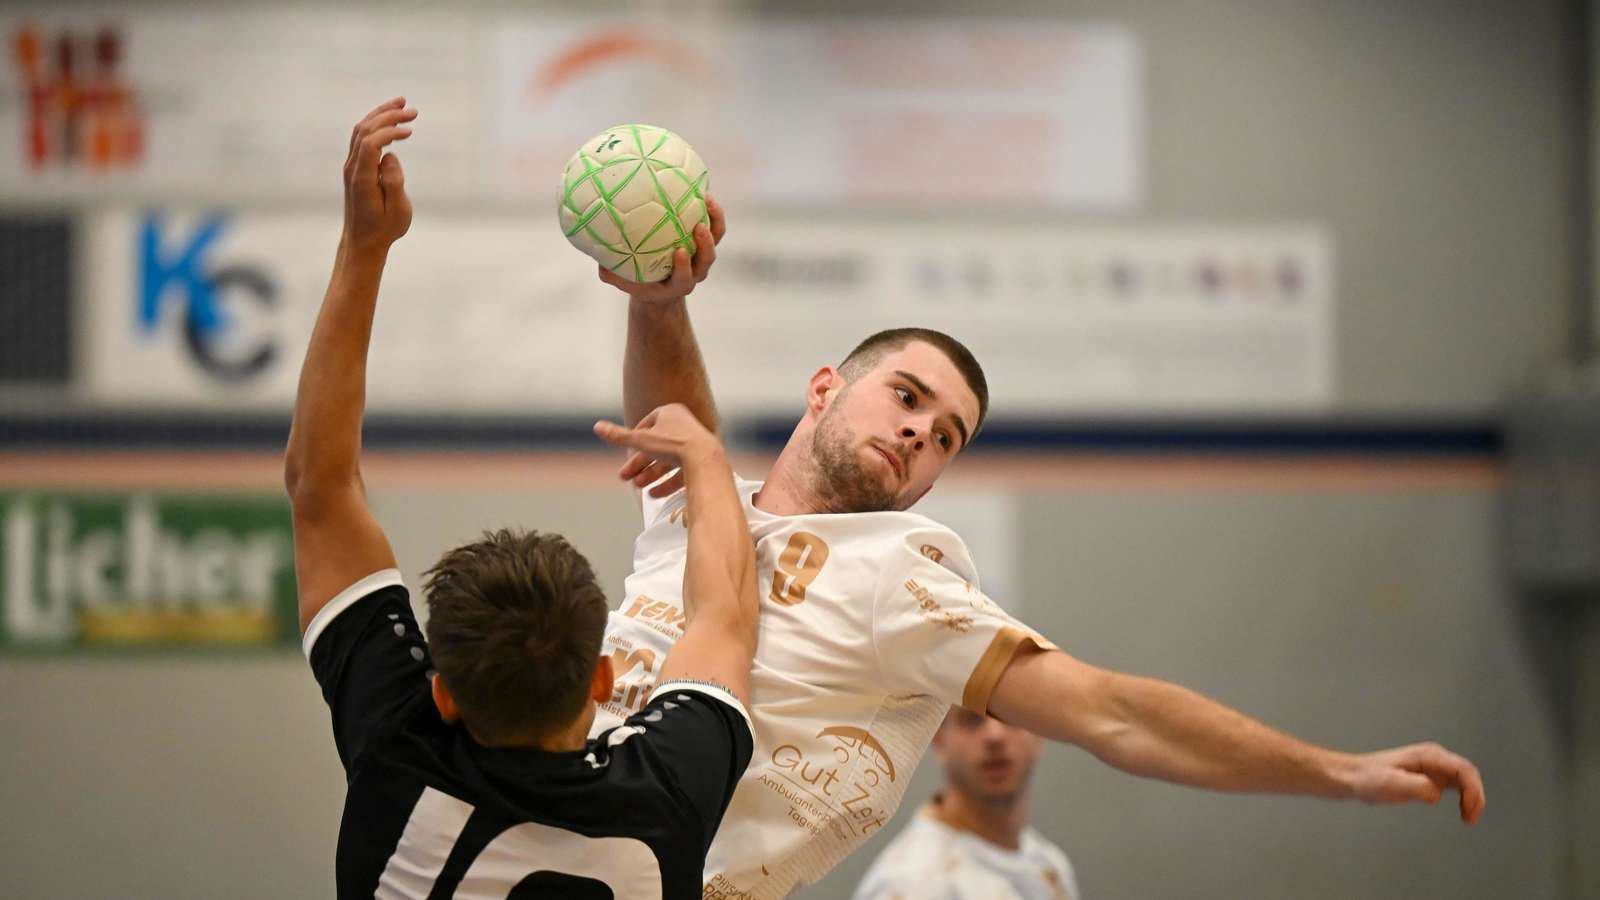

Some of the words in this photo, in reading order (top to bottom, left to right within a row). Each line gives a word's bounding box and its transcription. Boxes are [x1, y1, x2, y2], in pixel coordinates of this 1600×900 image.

[6, 492, 284, 640] Licher
[769, 531, 830, 606] 9
[771, 744, 840, 796] Gut
[841, 782, 887, 834] Zeit
